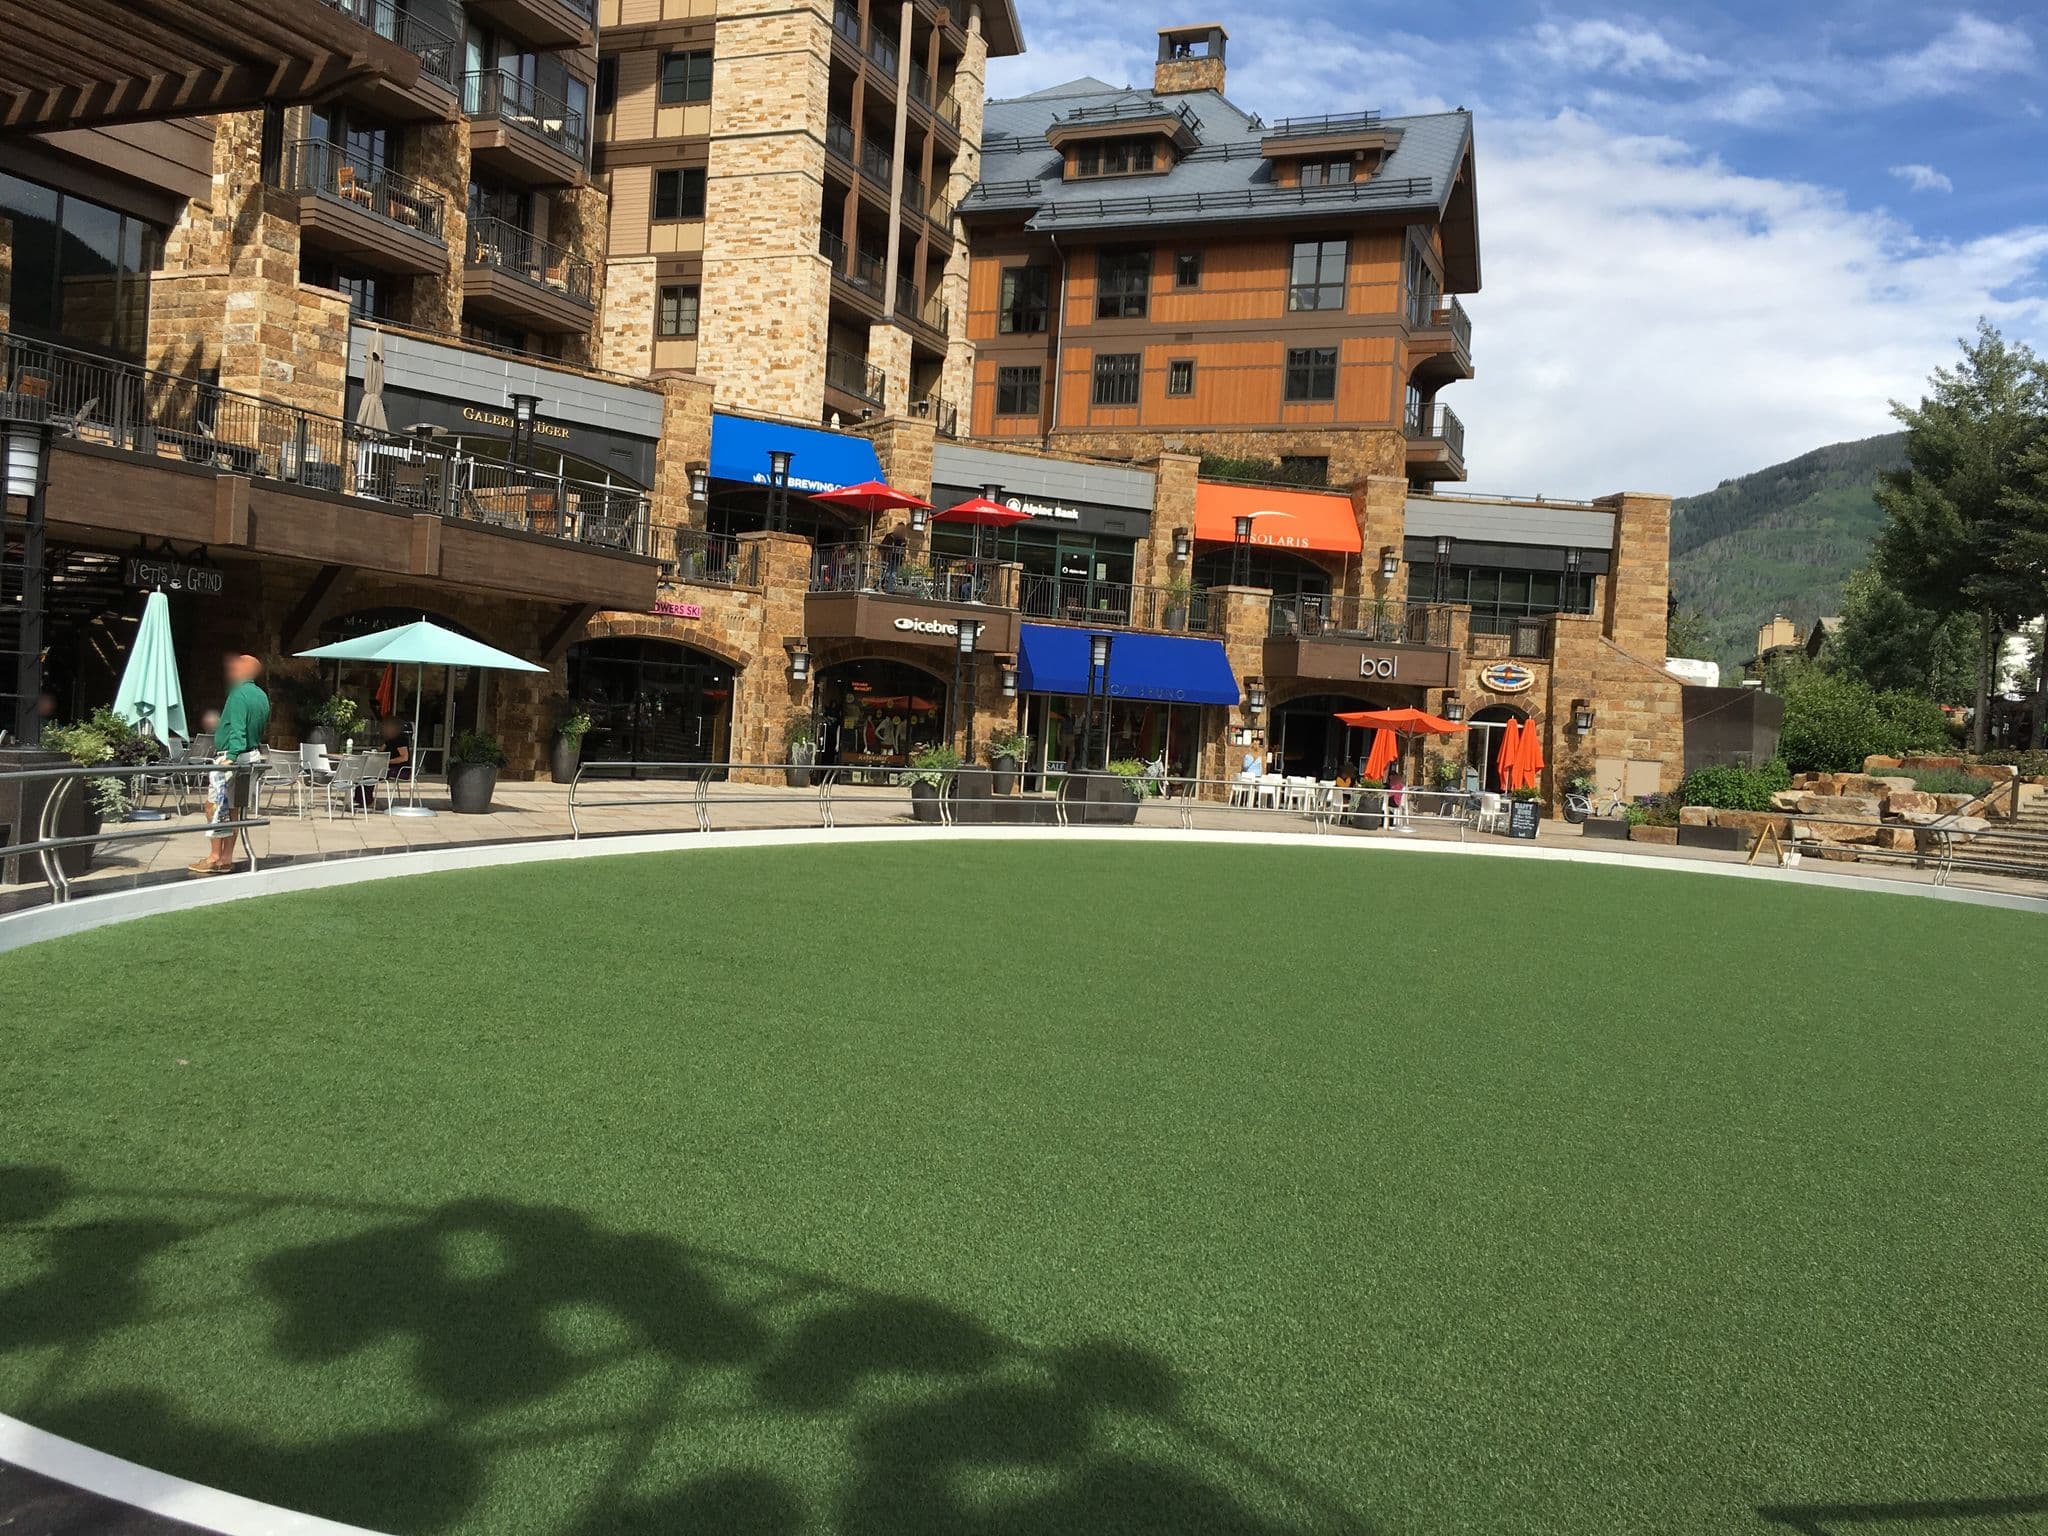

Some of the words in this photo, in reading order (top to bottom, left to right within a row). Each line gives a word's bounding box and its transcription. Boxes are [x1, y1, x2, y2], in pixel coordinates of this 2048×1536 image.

[787, 477, 834, 493] BREWING
[1021, 503, 1053, 516] Alpine
[1055, 506, 1079, 519] Bank
[1250, 534, 1309, 549] SOLARIS
[686, 606, 700, 616] SKI
[913, 617, 985, 637] icebrer
